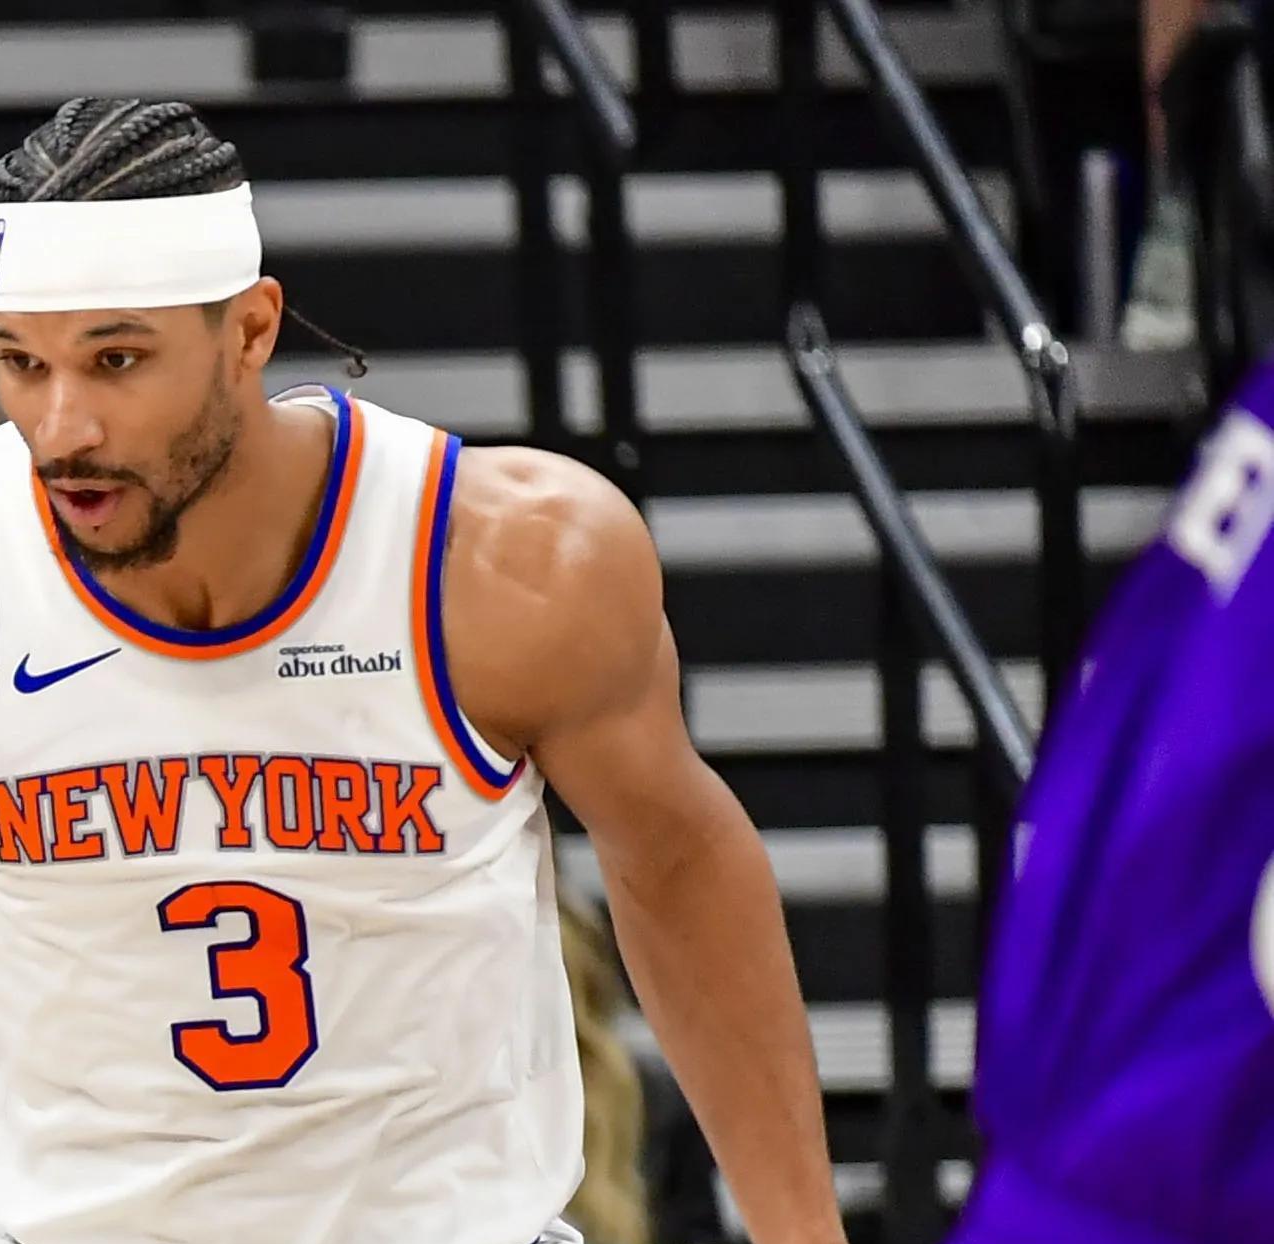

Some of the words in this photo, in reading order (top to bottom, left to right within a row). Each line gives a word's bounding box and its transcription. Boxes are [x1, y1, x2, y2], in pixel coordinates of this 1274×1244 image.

[278, 656, 325, 678] abu
[330, 649, 401, 675] dhabi
[279, 643, 345, 656] experience
[197, 752, 446, 856] YORK
[156, 880, 319, 1091] 3
